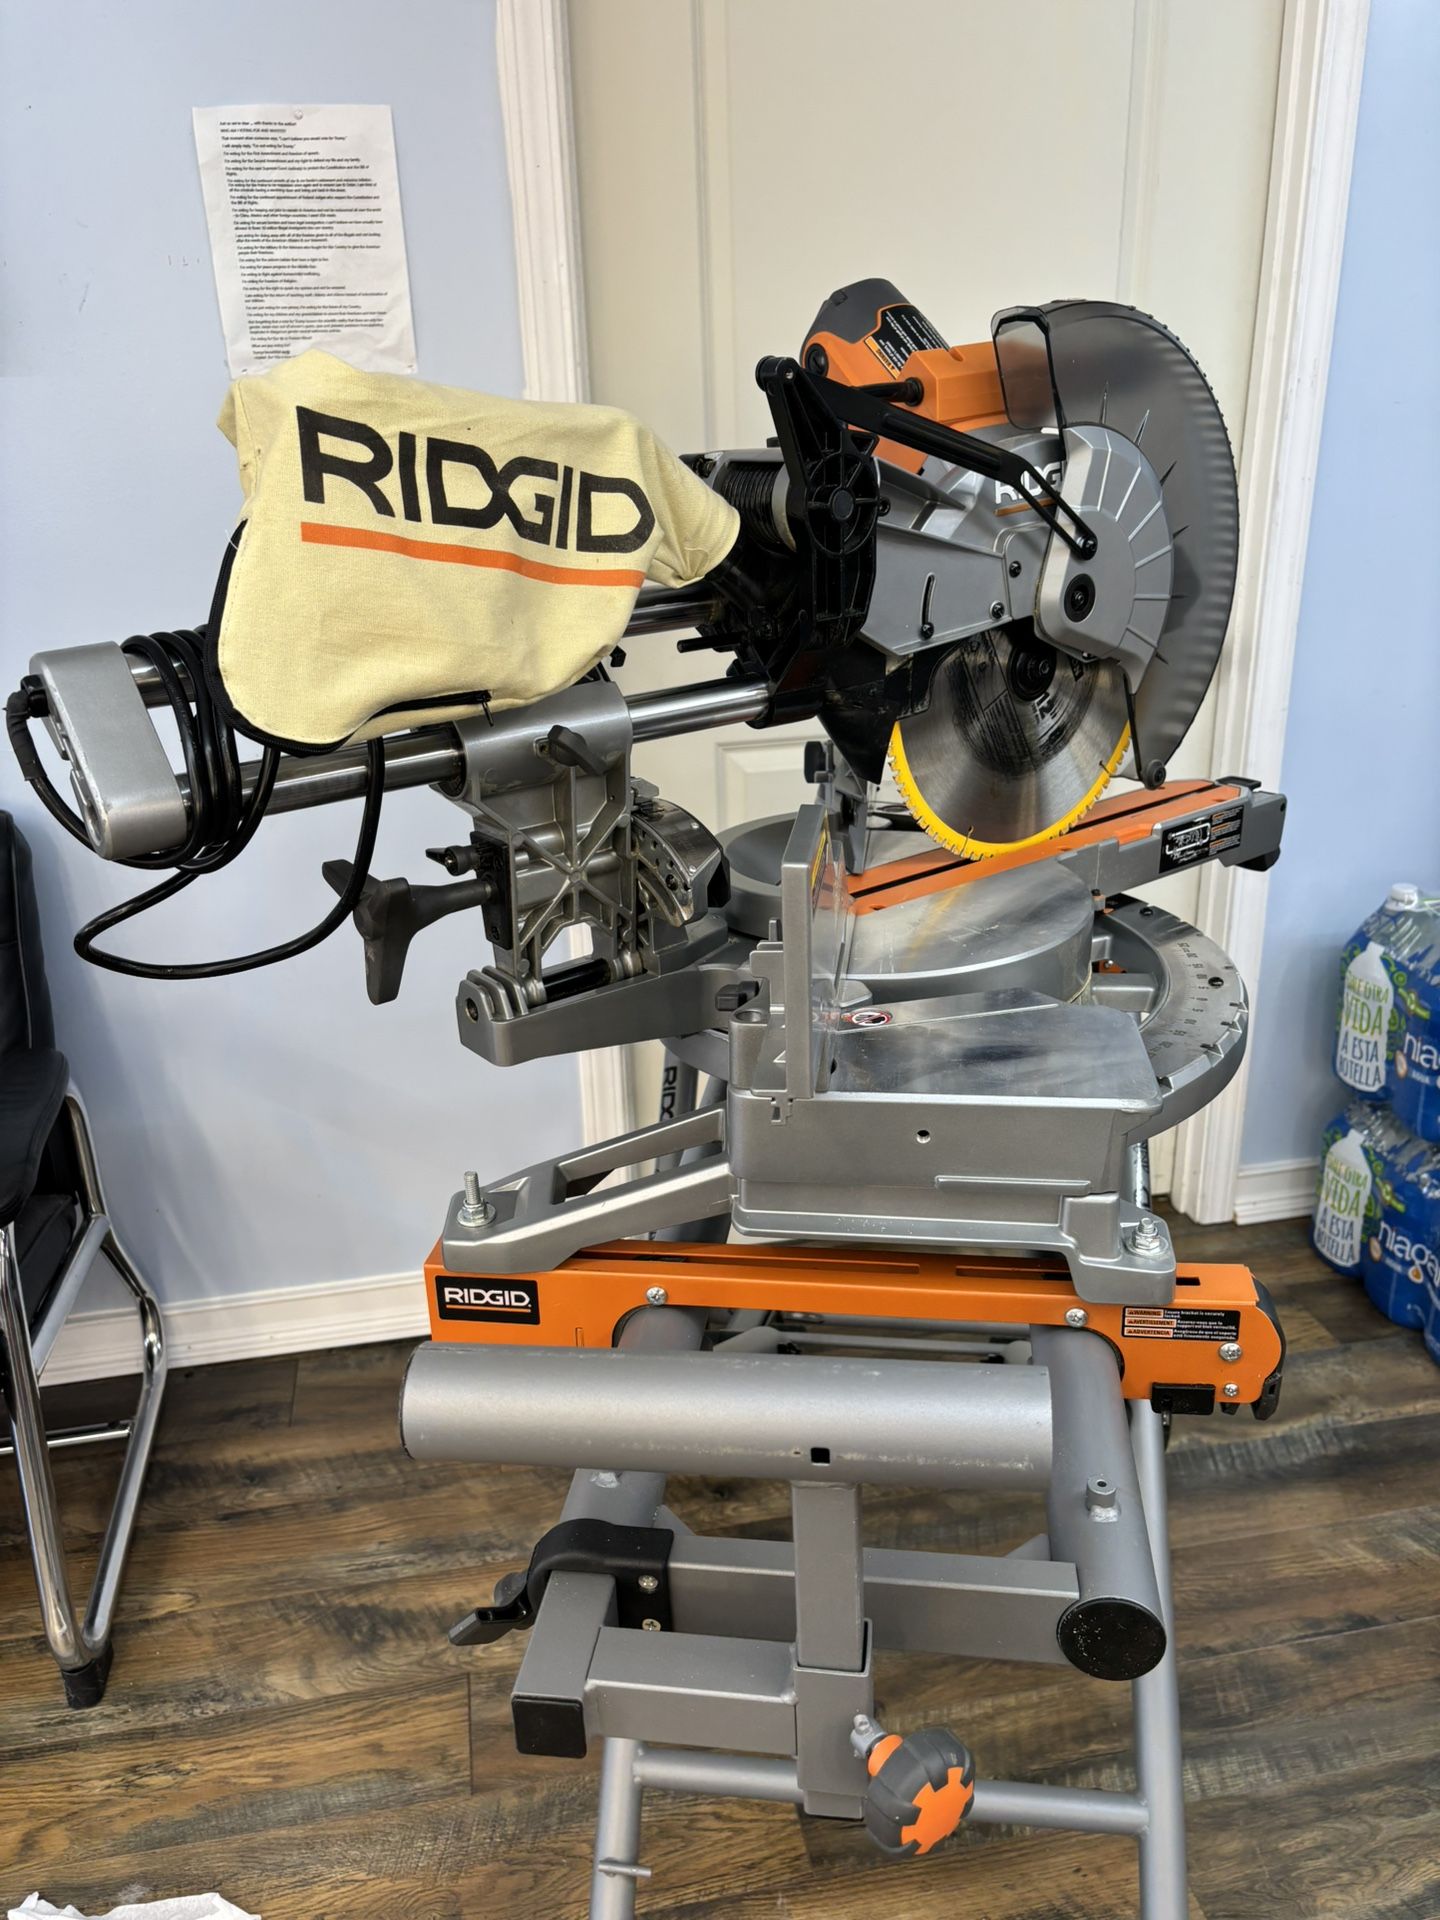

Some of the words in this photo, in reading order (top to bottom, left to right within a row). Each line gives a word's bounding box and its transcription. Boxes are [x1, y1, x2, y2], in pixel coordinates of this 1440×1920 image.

[296, 405, 656, 554] RIDGID
[1344, 991, 1383, 1037] VIDA
[1341, 1031, 1348, 1054] A
[1352, 1036, 1379, 1063] ESTA
[1339, 1054, 1382, 1088] BOTELLA
[1324, 1170, 1361, 1217] VIDA
[1320, 1206, 1328, 1229] A
[1329, 1214, 1354, 1241] ESTA
[443, 1286, 531, 1308] RIDGID
